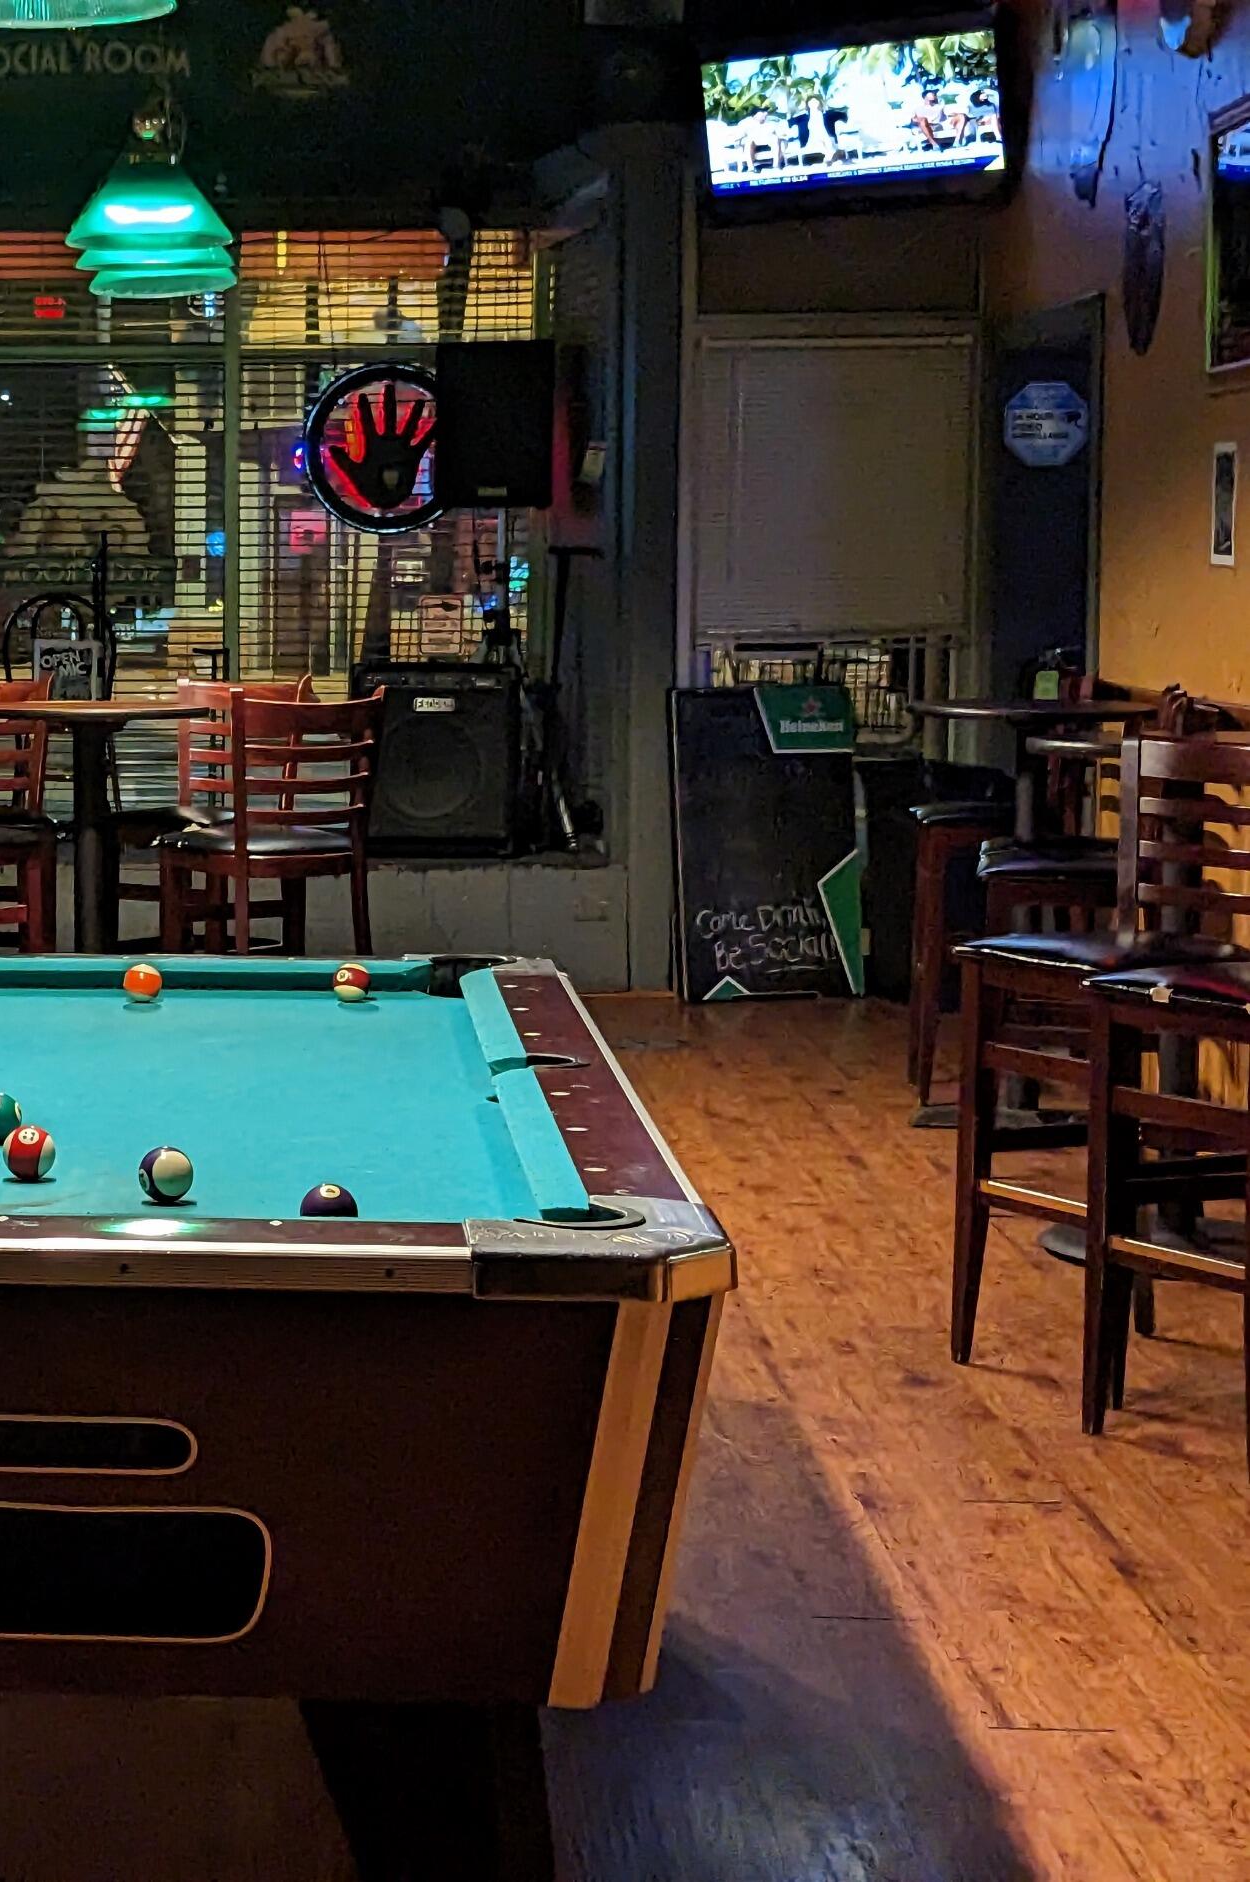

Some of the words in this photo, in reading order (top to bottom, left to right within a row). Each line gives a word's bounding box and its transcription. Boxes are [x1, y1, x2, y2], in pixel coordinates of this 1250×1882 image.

[83, 40, 191, 78] ROOM
[40, 650, 81, 669] OPEN
[58, 661, 87, 677] MIC
[696, 909, 756, 939] Come
[714, 940, 746, 972] Be
